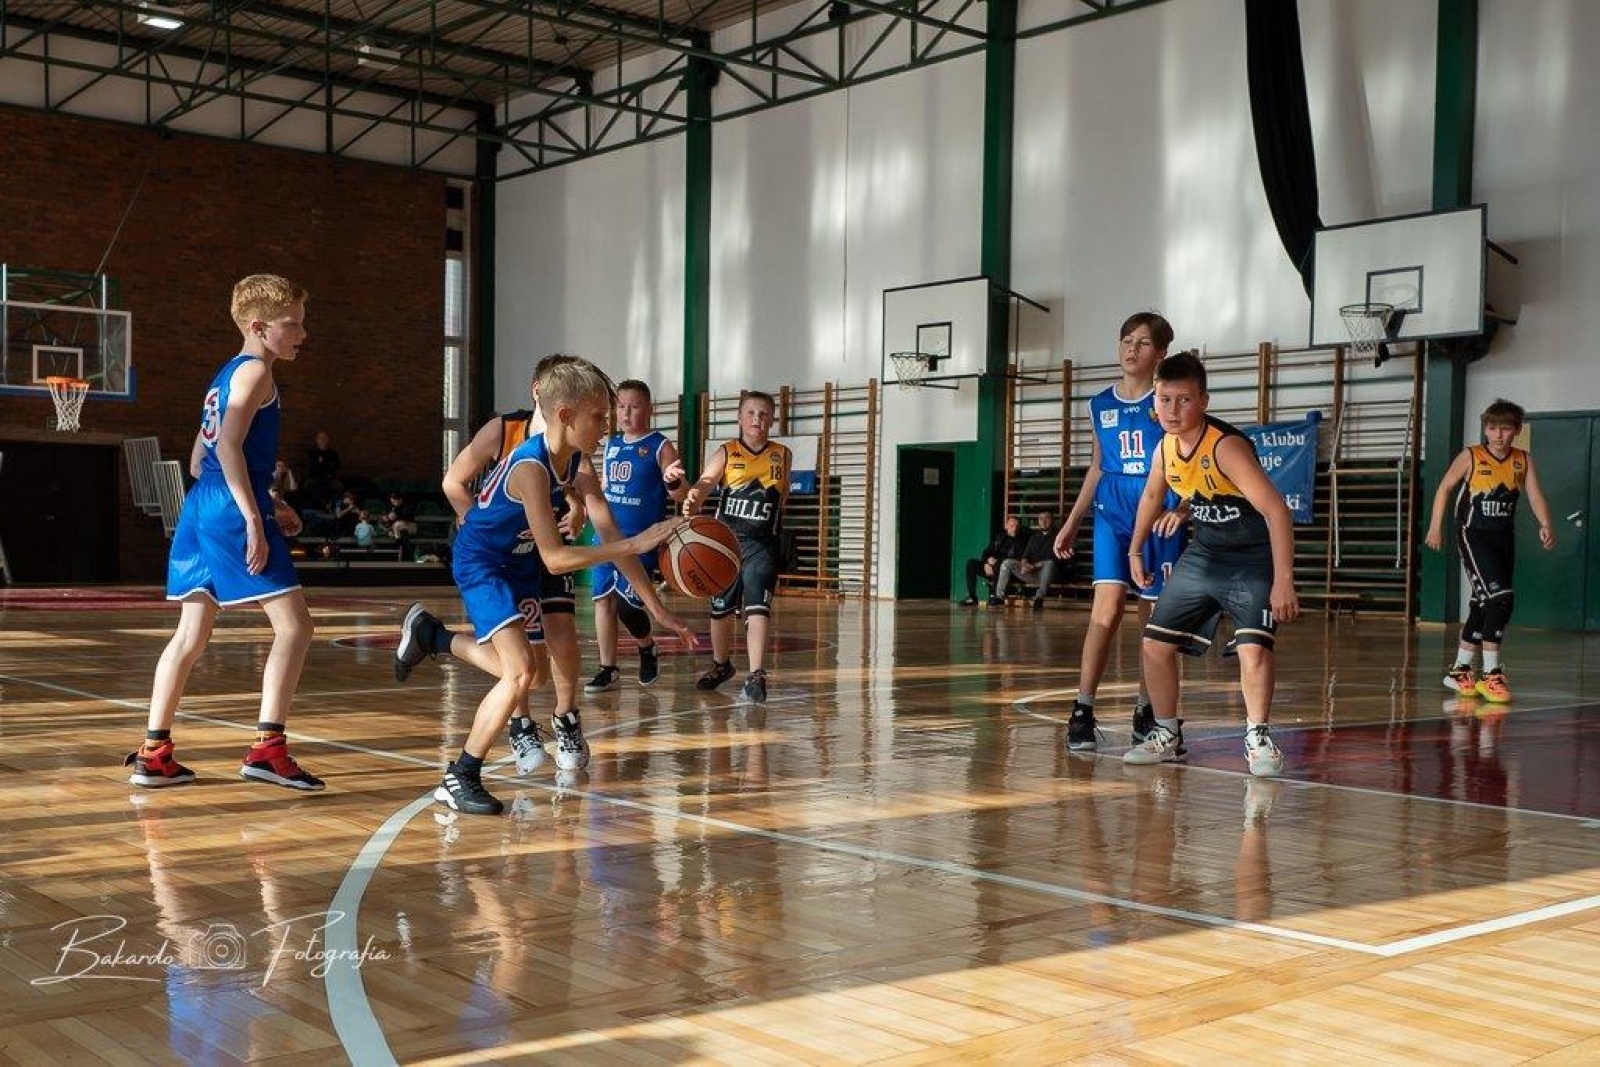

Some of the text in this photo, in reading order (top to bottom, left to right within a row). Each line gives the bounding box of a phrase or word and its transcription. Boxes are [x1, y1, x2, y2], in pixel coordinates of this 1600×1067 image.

[1118, 430, 1146, 459] 11
[1261, 431, 1306, 447] klubu
[1259, 452, 1282, 471] uje
[610, 461, 632, 482] 10
[769, 465, 782, 480] 18
[724, 496, 773, 521] HILLS
[1284, 494, 1301, 510] ki
